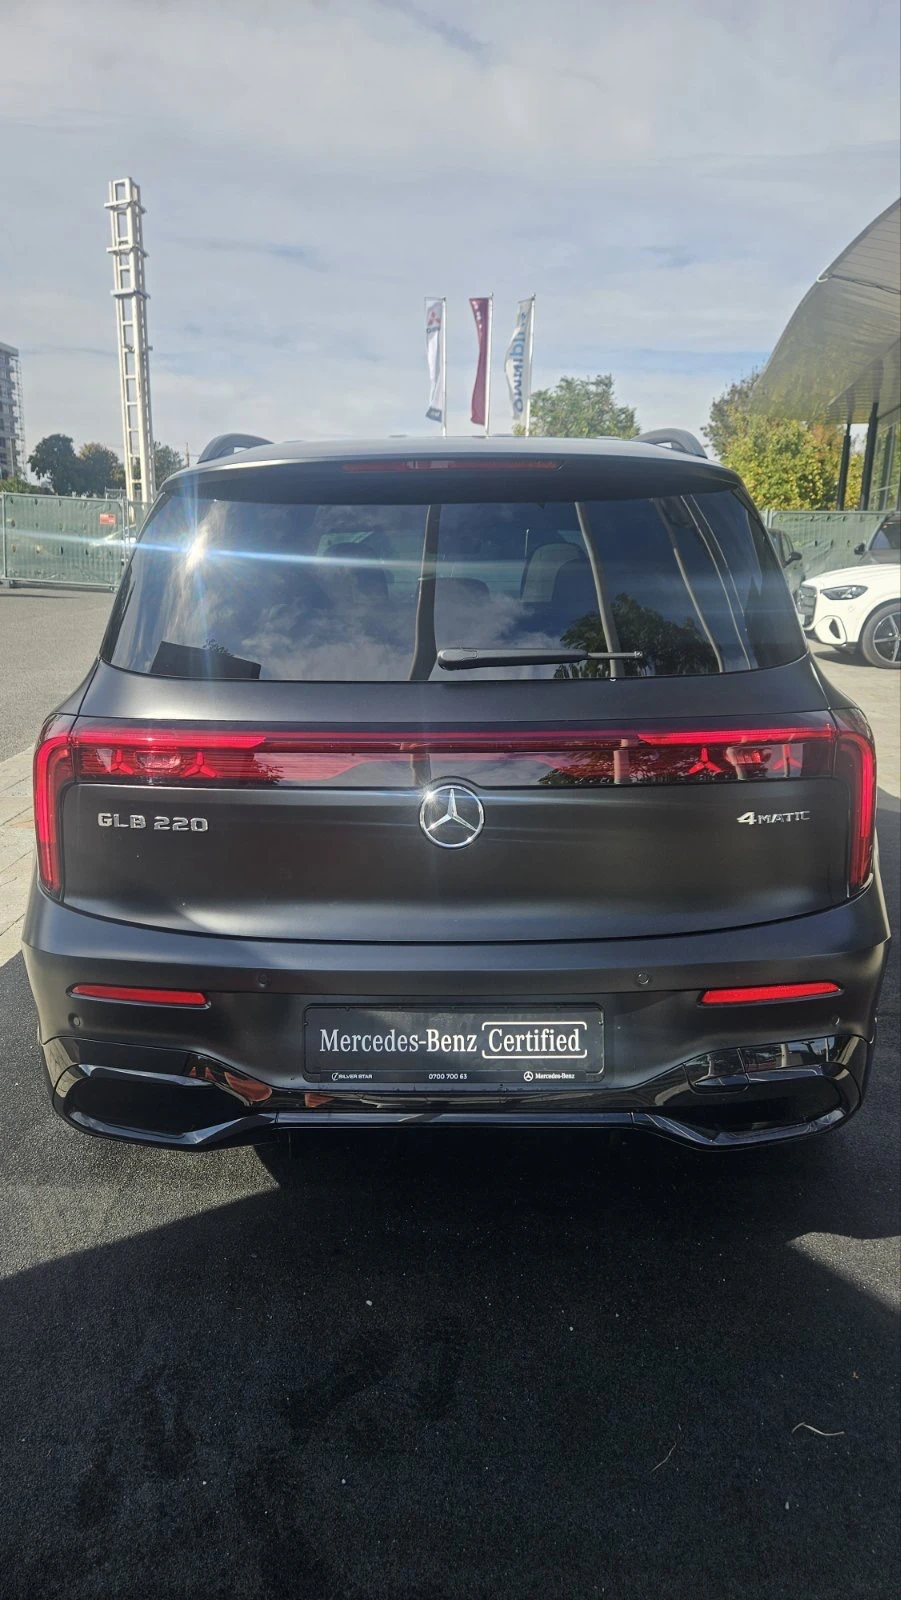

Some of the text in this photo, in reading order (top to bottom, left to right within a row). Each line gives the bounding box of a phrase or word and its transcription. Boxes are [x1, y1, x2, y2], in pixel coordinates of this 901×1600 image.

[97, 812, 209, 832] GLB 220
[736, 810, 811, 825] 4MATIC
[319, 1028, 581, 1052] Mercedes-Benz Certified
[534, 1072, 576, 1080] Mercedes-Benz
